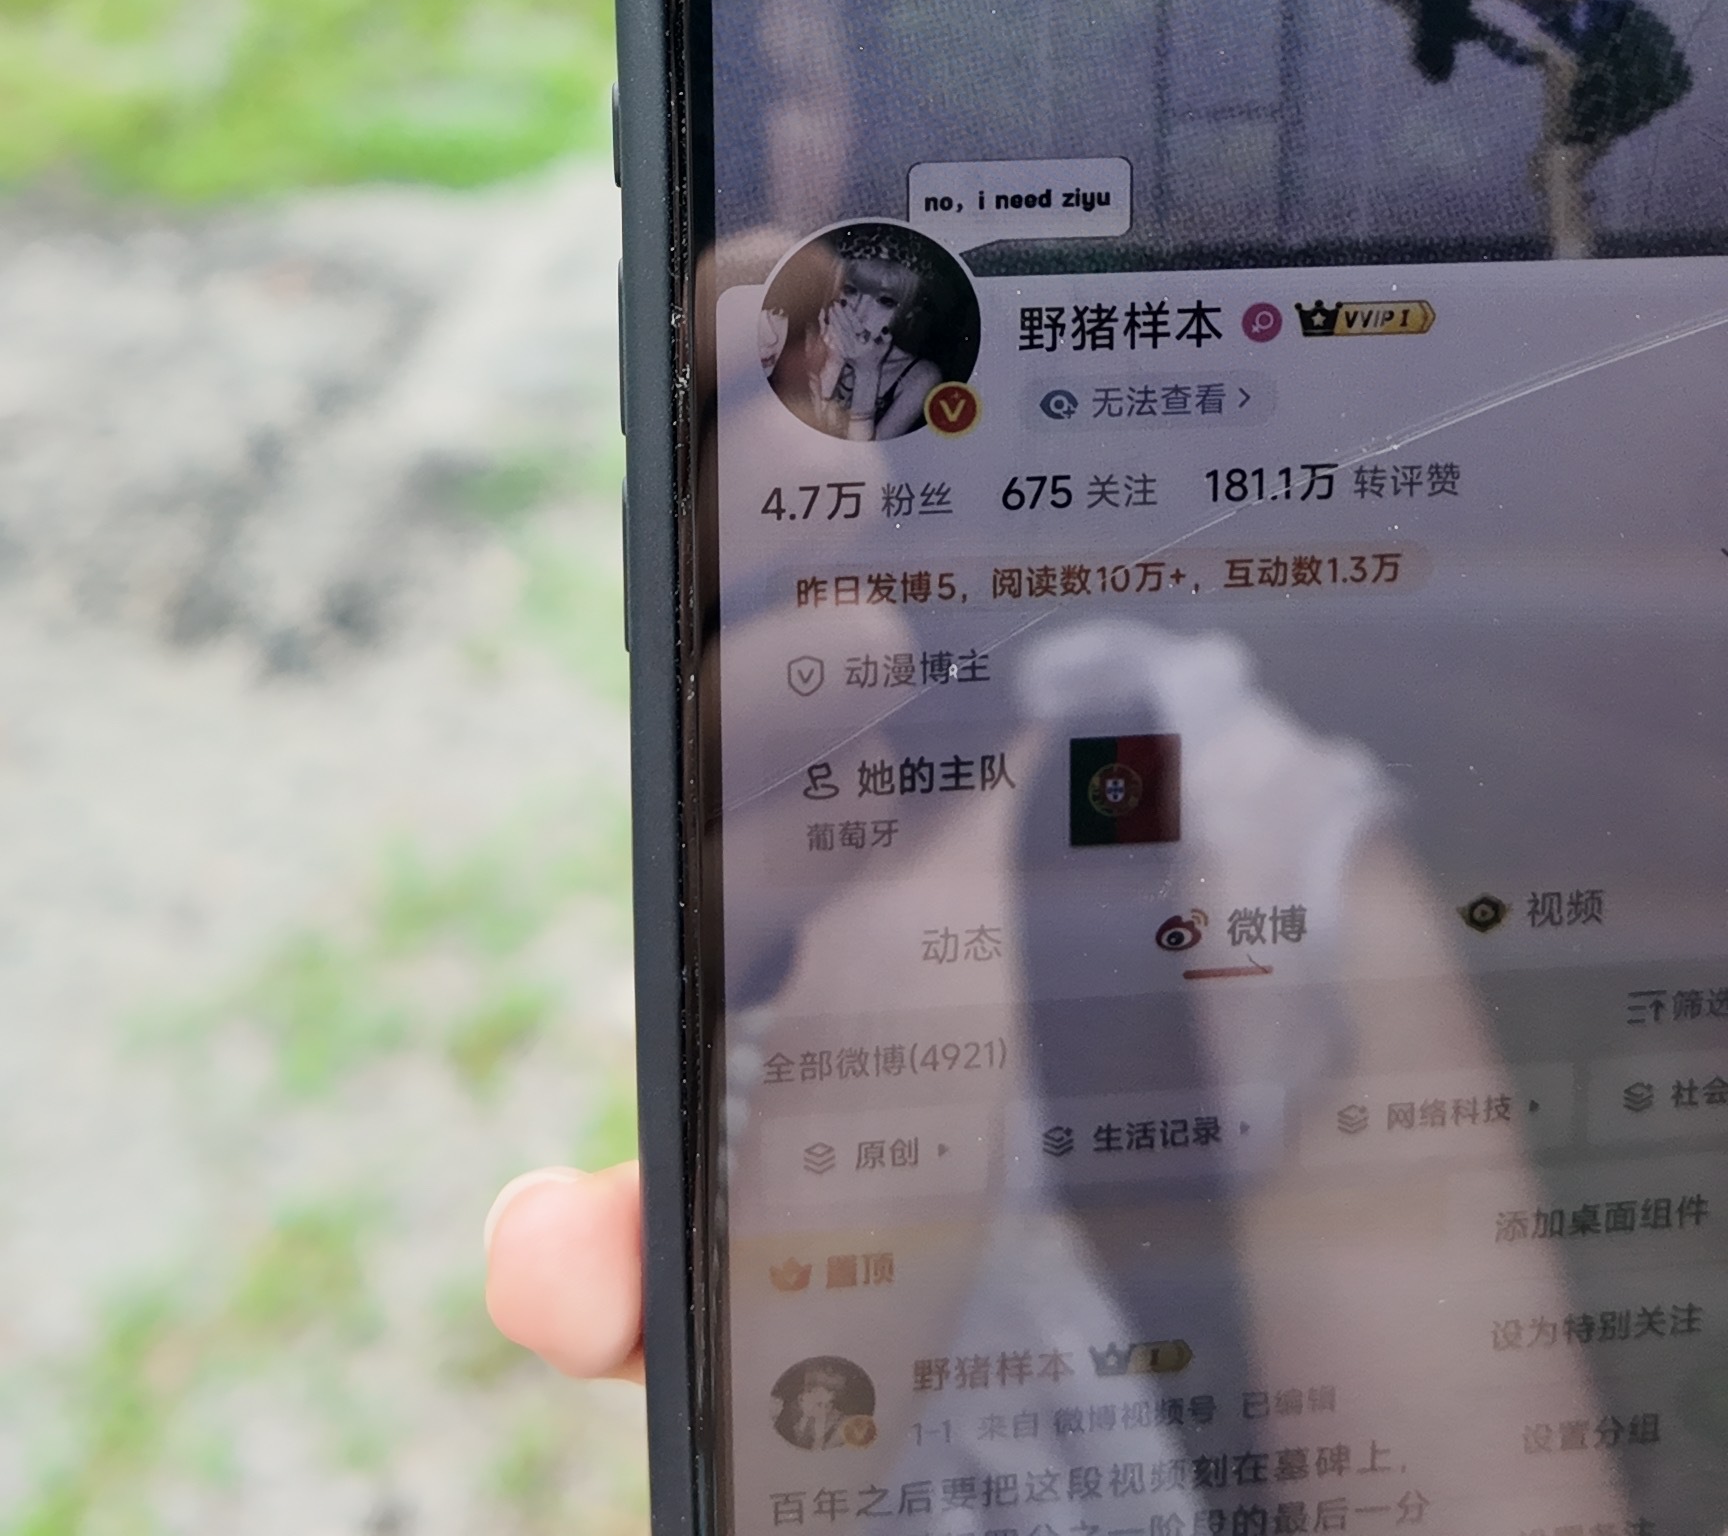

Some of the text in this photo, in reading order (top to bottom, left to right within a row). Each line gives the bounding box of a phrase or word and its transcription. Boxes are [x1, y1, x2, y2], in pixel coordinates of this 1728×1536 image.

[977, 190, 985, 211] i
[995, 188, 1052, 209] need
[1062, 188, 1110, 212] ziyu
[1018, 300, 1223, 352] 野猪样本
[1092, 382, 1226, 419] 无法查看
[761, 462, 1460, 521] 4.7万 粉丝 675 关注 181.1万 转评赞
[845, 648, 991, 689] 动漫博主
[857, 753, 1016, 797] 她的主队
[806, 819, 899, 852] 葡萄牙
[1227, 904, 1308, 946] 微博
[1527, 888, 1605, 928] 视频
[921, 924, 1003, 964] 动态
[763, 1037, 1007, 1085] 全部微博(4921)
[1387, 1094, 1512, 1131] 网络科技
[855, 1137, 919, 1170] 原创
[1093, 1115, 1222, 1153] 生活记录
[1494, 1193, 1710, 1244] 添加桌面组件
[826, 1252, 894, 1289] 置顶
[1491, 1302, 1704, 1352] 设为特别关注
[911, 1350, 1076, 1392] 野猪样本
[977, 1411, 1040, 1441] 来自
[1053, 1394, 1217, 1435] 微博视频号
[1241, 1384, 1338, 1421] 已编辑
[1522, 1412, 1661, 1454] 设置分组
